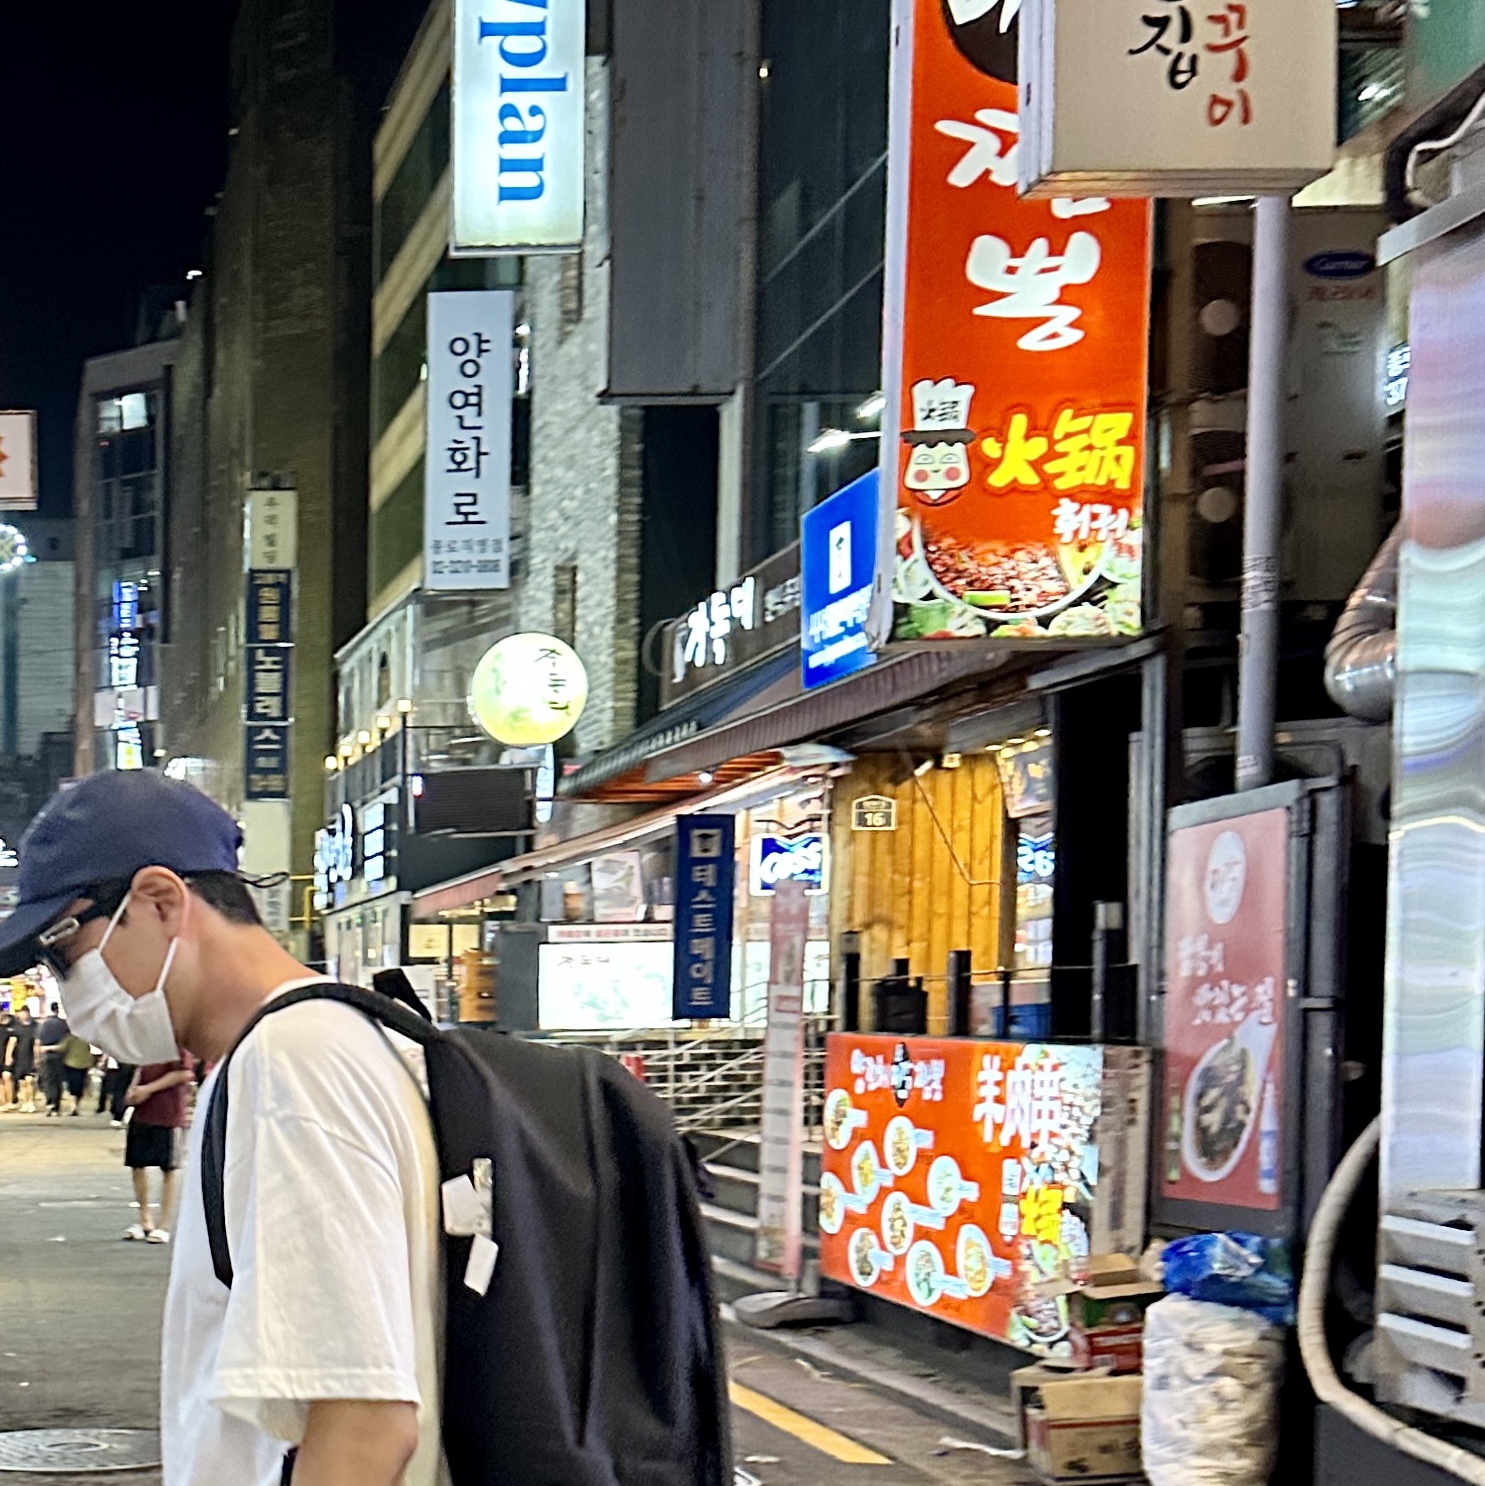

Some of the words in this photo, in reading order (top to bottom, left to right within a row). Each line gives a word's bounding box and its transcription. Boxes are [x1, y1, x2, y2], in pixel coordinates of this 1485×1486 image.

[1126, 0, 1199, 90] 집
[477, 0, 568, 205] plan
[445, 331, 491, 526] 양연화로
[981, 408, 1135, 490] 火锅
[1050, 497, 1130, 543] 훠궈
[864, 812, 886, 826] 16
